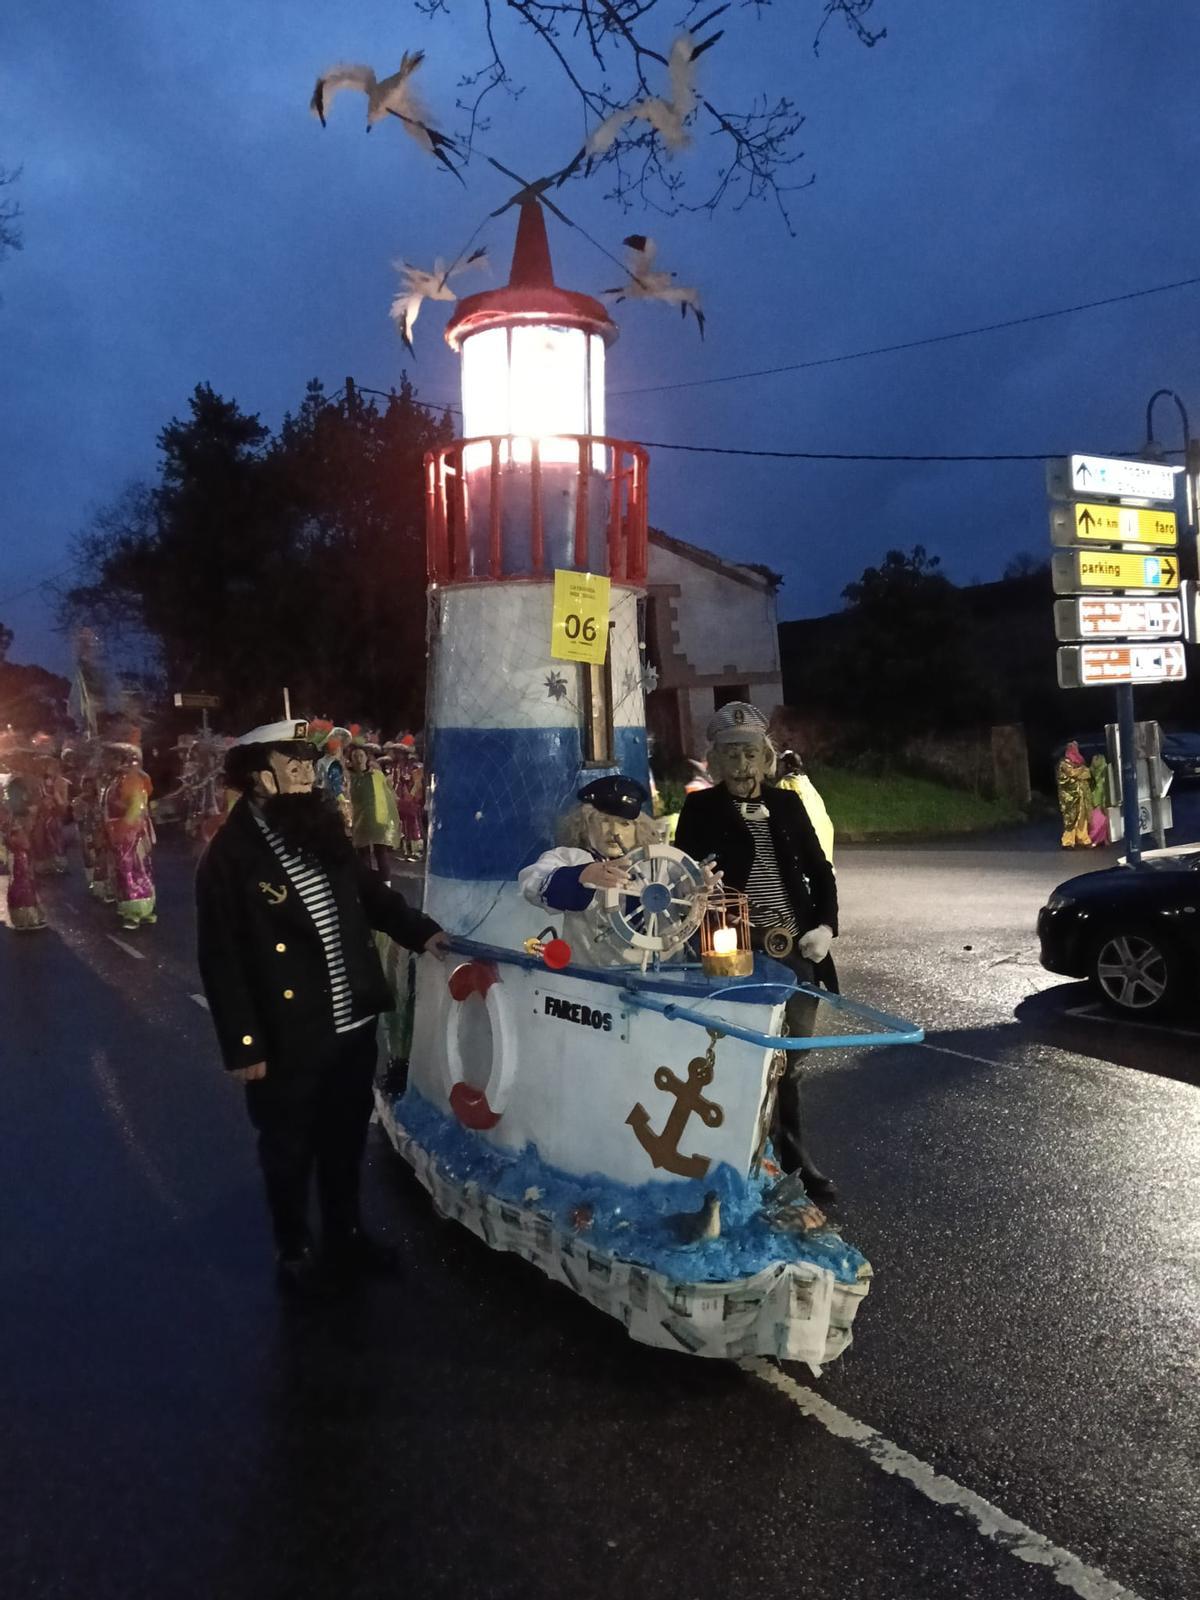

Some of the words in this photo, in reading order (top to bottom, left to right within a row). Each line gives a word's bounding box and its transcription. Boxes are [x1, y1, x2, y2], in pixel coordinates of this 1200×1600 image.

[1096, 517, 1103, 528] 4
[1106, 518, 1119, 529] km
[1155, 520, 1175, 535] faro
[1081, 561, 1121, 577] parking
[564, 614, 597, 642] 06
